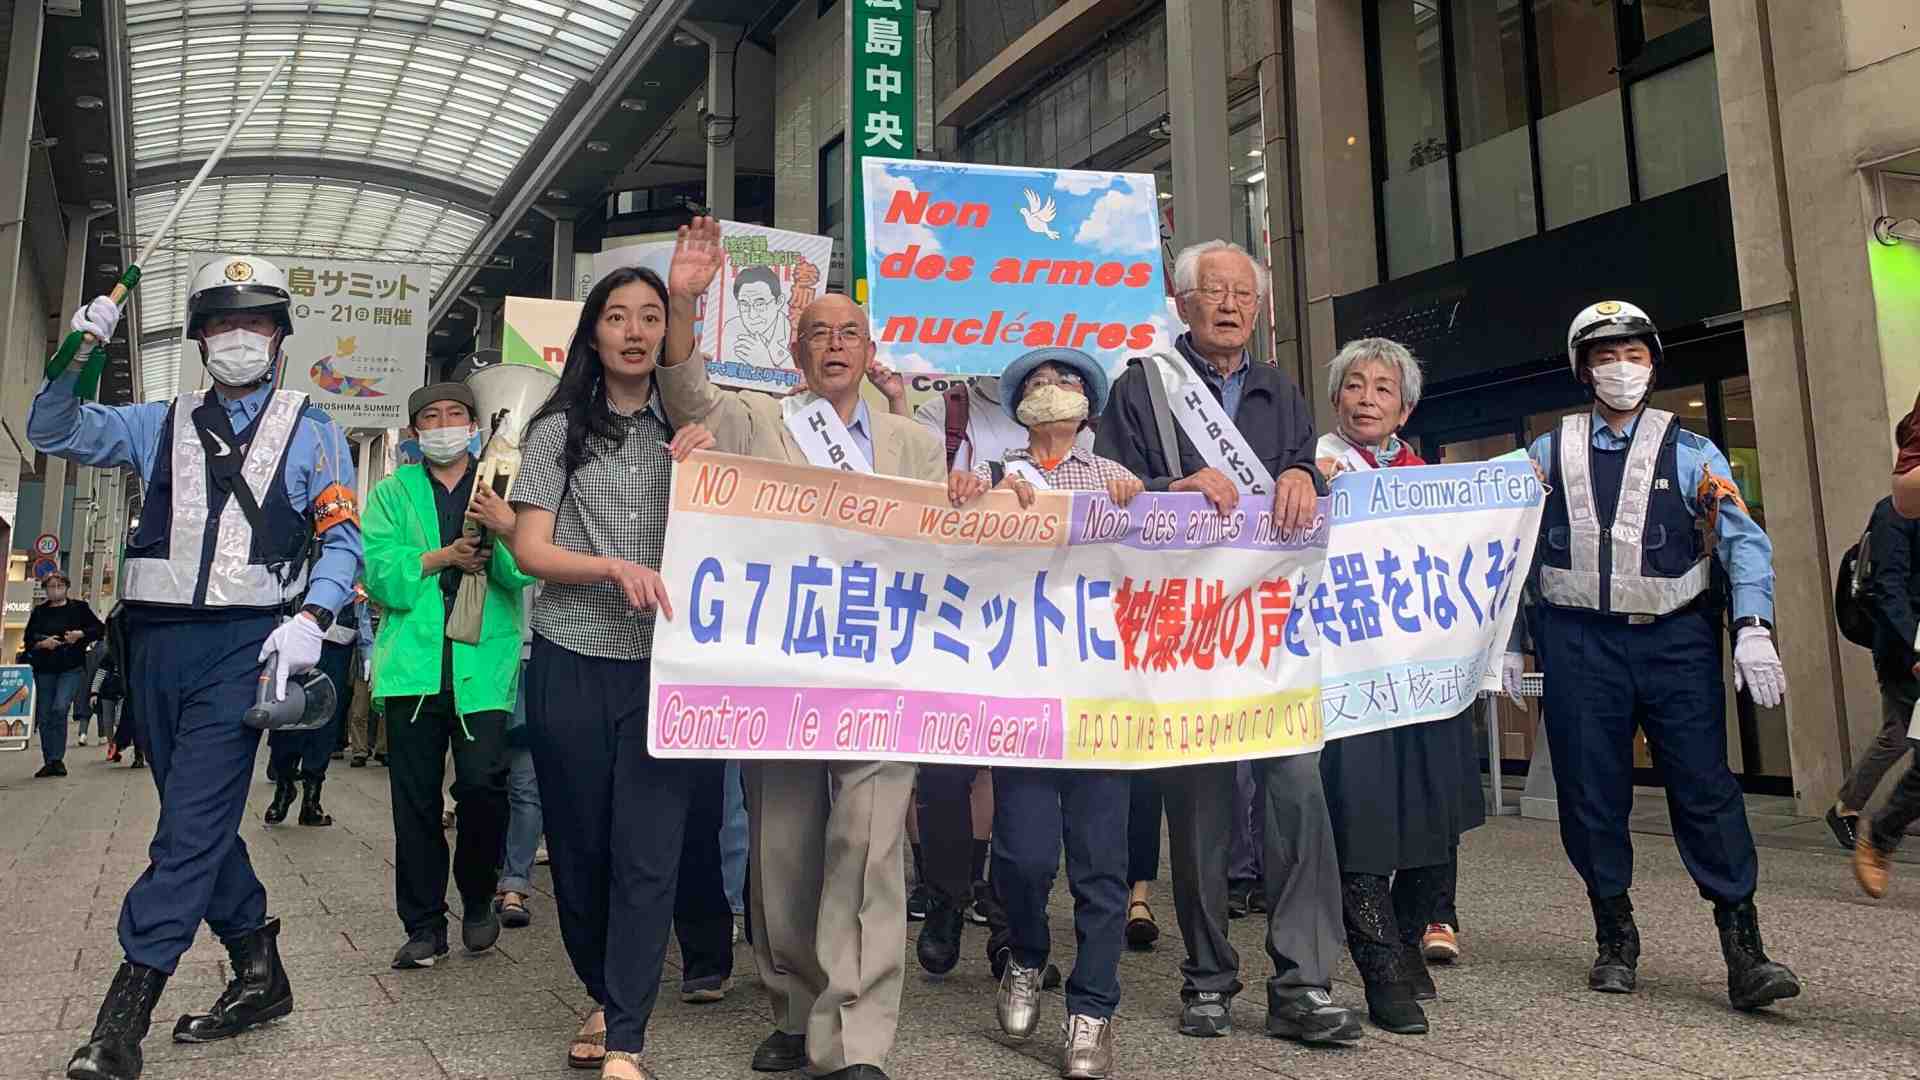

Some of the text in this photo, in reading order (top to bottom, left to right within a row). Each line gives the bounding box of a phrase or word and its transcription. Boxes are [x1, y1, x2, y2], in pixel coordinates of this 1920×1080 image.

[883, 189, 991, 229] Non
[287, 266, 420, 301] 島サミット
[879, 245, 975, 282] des
[990, 255, 1153, 288] armes
[880, 311, 1157, 351] nucléaires
[364, 403, 400, 413] SUMMIT
[692, 464, 1058, 545] NO nuclear weapons
[1370, 467, 1538, 513] Atomwaffen
[1082, 497, 1131, 540] Non
[1141, 497, 1177, 542] des
[1186, 510, 1245, 543] armes
[661, 693, 1049, 757] Contro le armi nucleari
